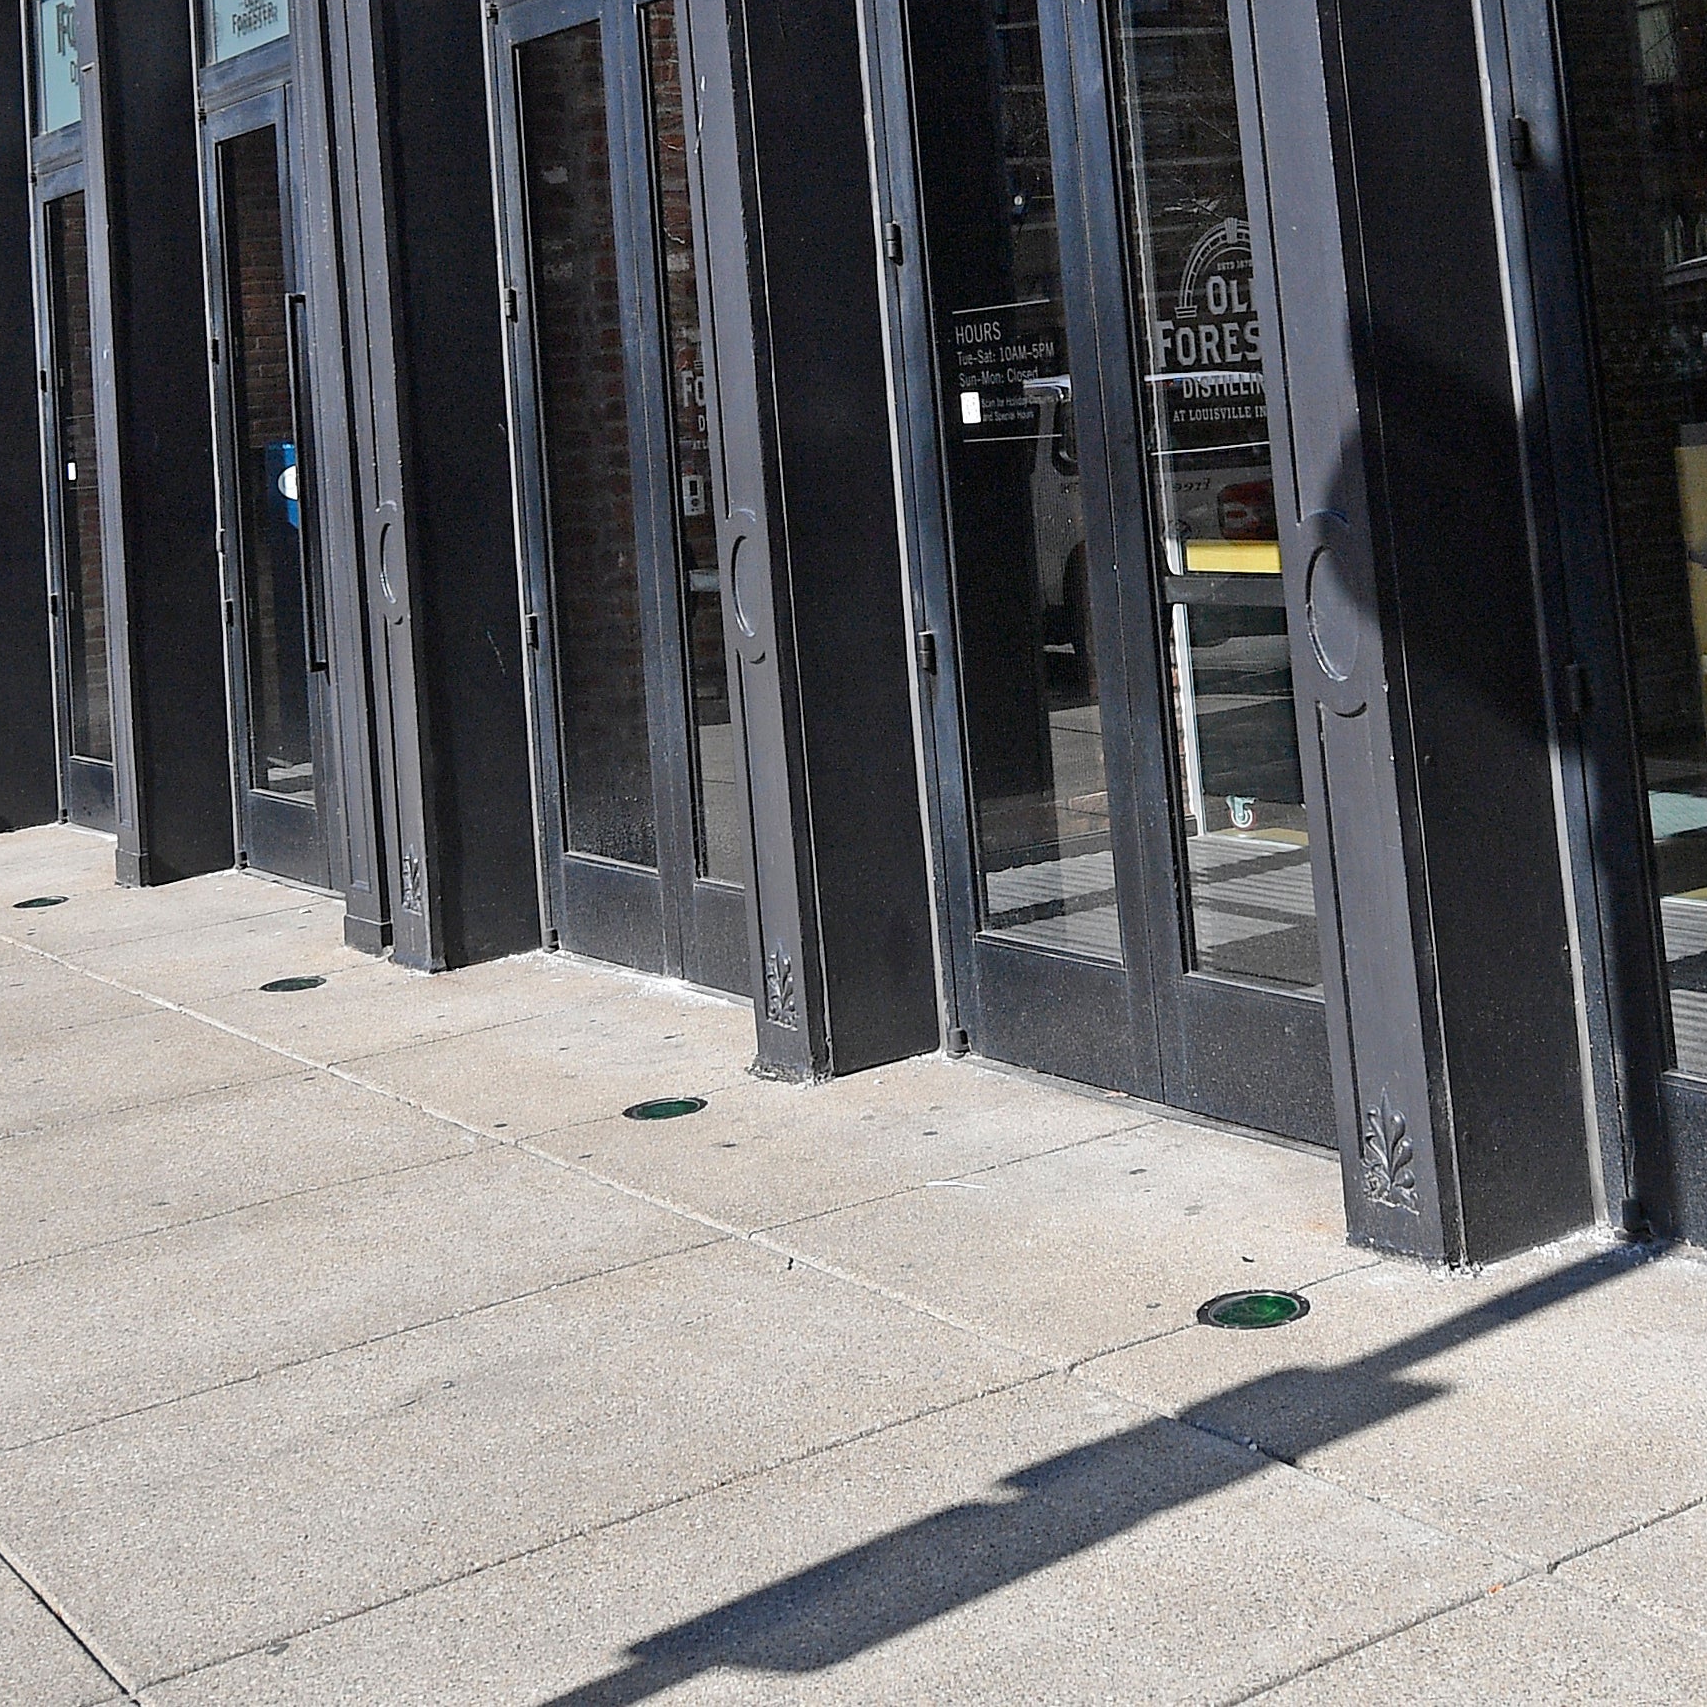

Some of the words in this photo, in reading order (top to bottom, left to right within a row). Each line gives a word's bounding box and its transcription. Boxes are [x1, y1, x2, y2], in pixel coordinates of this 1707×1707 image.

[955, 321, 1002, 345] HOURS
[1156, 319, 1262, 369] FORES
[957, 349, 996, 366] Tue-Sat:
[1000, 341, 1054, 362] 10AM-5PM
[959, 370, 1005, 388] Sun-Mon:
[1006, 366, 1039, 383] Closed
[1189, 407, 1251, 422] LOUISVILLE
